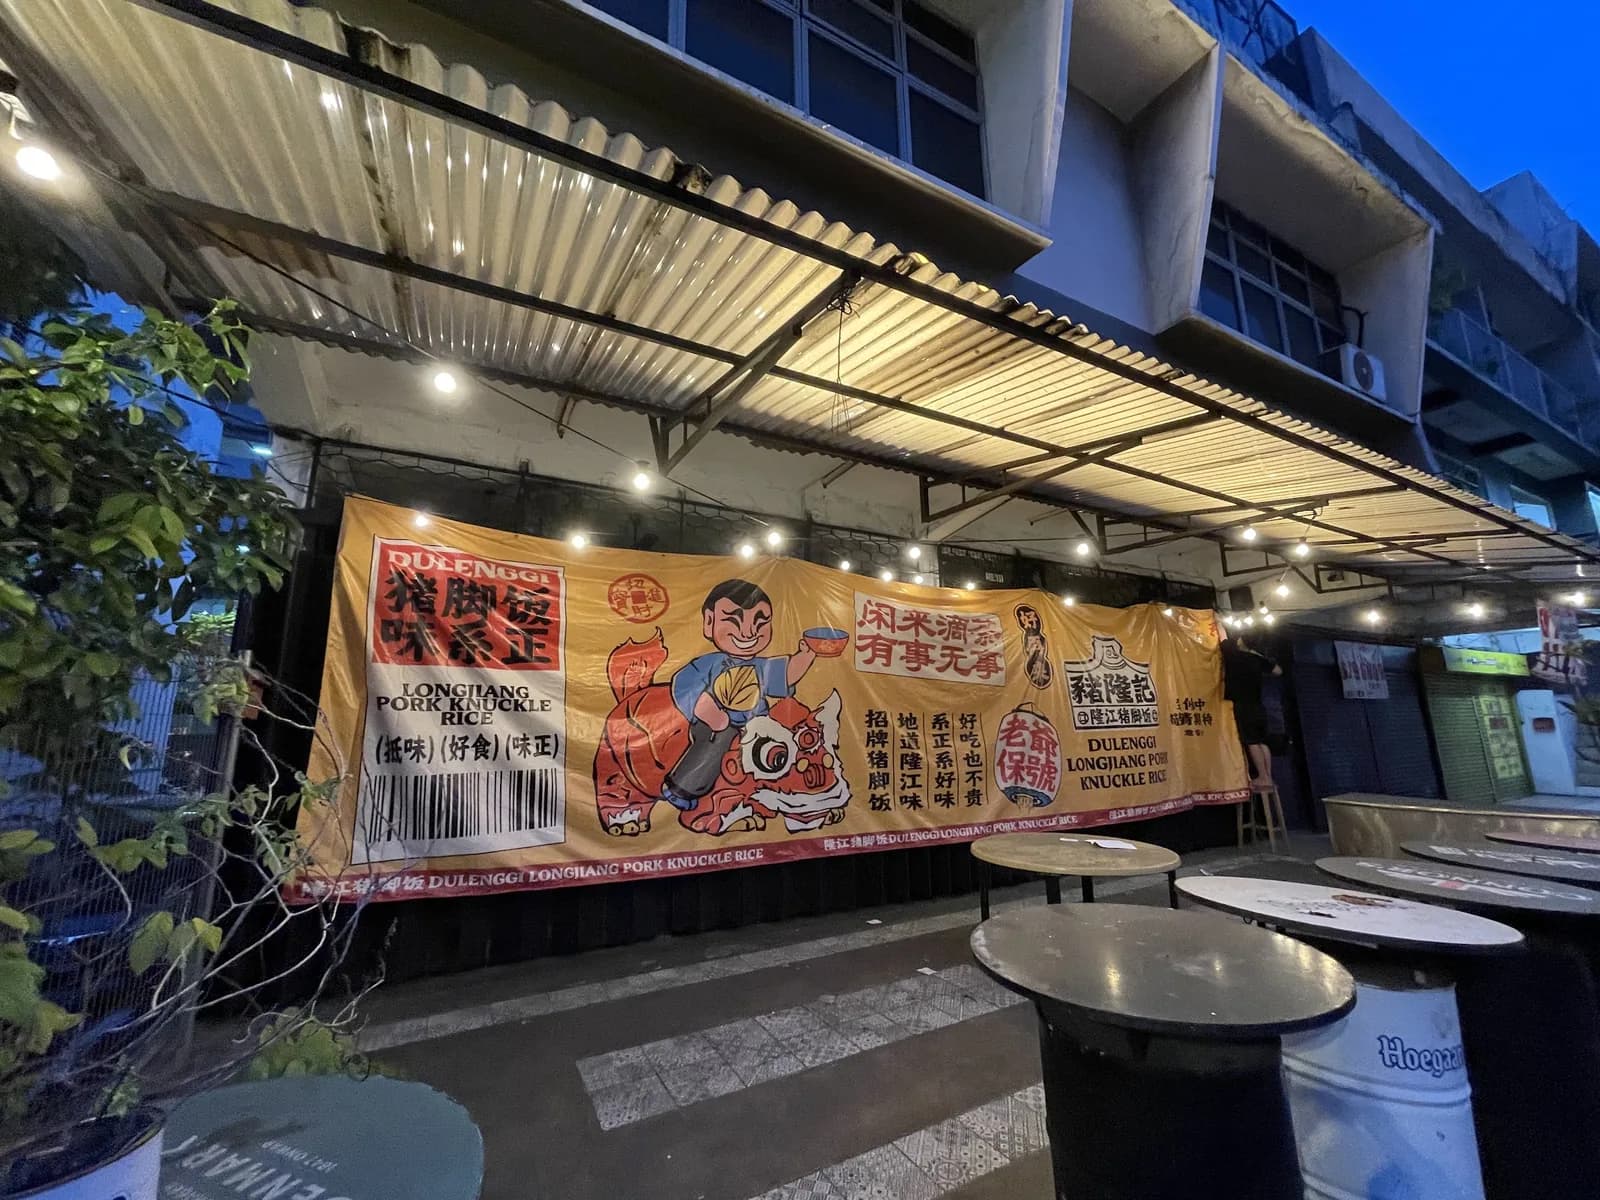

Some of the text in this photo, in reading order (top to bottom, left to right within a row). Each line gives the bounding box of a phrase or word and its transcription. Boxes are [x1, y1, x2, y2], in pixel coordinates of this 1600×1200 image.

[388, 550, 550, 584] DULENGGI
[385, 570, 553, 625] 猪脚饭
[381, 616, 552, 664] 味系正
[855, 633, 1004, 680] 有事无事
[376, 696, 552, 713] PORK KNUCKLE
[402, 683, 529, 699] LONGJIANG
[440, 712, 494, 726] RICE
[864, 709, 892, 812] 招牌猪脚饭
[897, 712, 924, 811] 地道隆江味
[931, 711, 956, 809] 系正系好味
[959, 712, 984, 807] 好吃也不贵
[1087, 735, 1157, 752] DULENGGI
[1066, 754, 1147, 772] LONGJIANG
[1080, 769, 1168, 790] KNUCKLE RICE
[889, 829, 940, 845] DULENGGI
[993, 820, 1018, 833] PORK
[1018, 817, 1058, 830] KNUCKLE
[1059, 815, 1079, 825] RICE
[428, 871, 524, 890] DULENGGI
[528, 863, 620, 883] LONGJIANG
[623, 858, 663, 874] PORK
[667, 852, 732, 870] KNUCKLE
[735, 848, 764, 860] RICE
